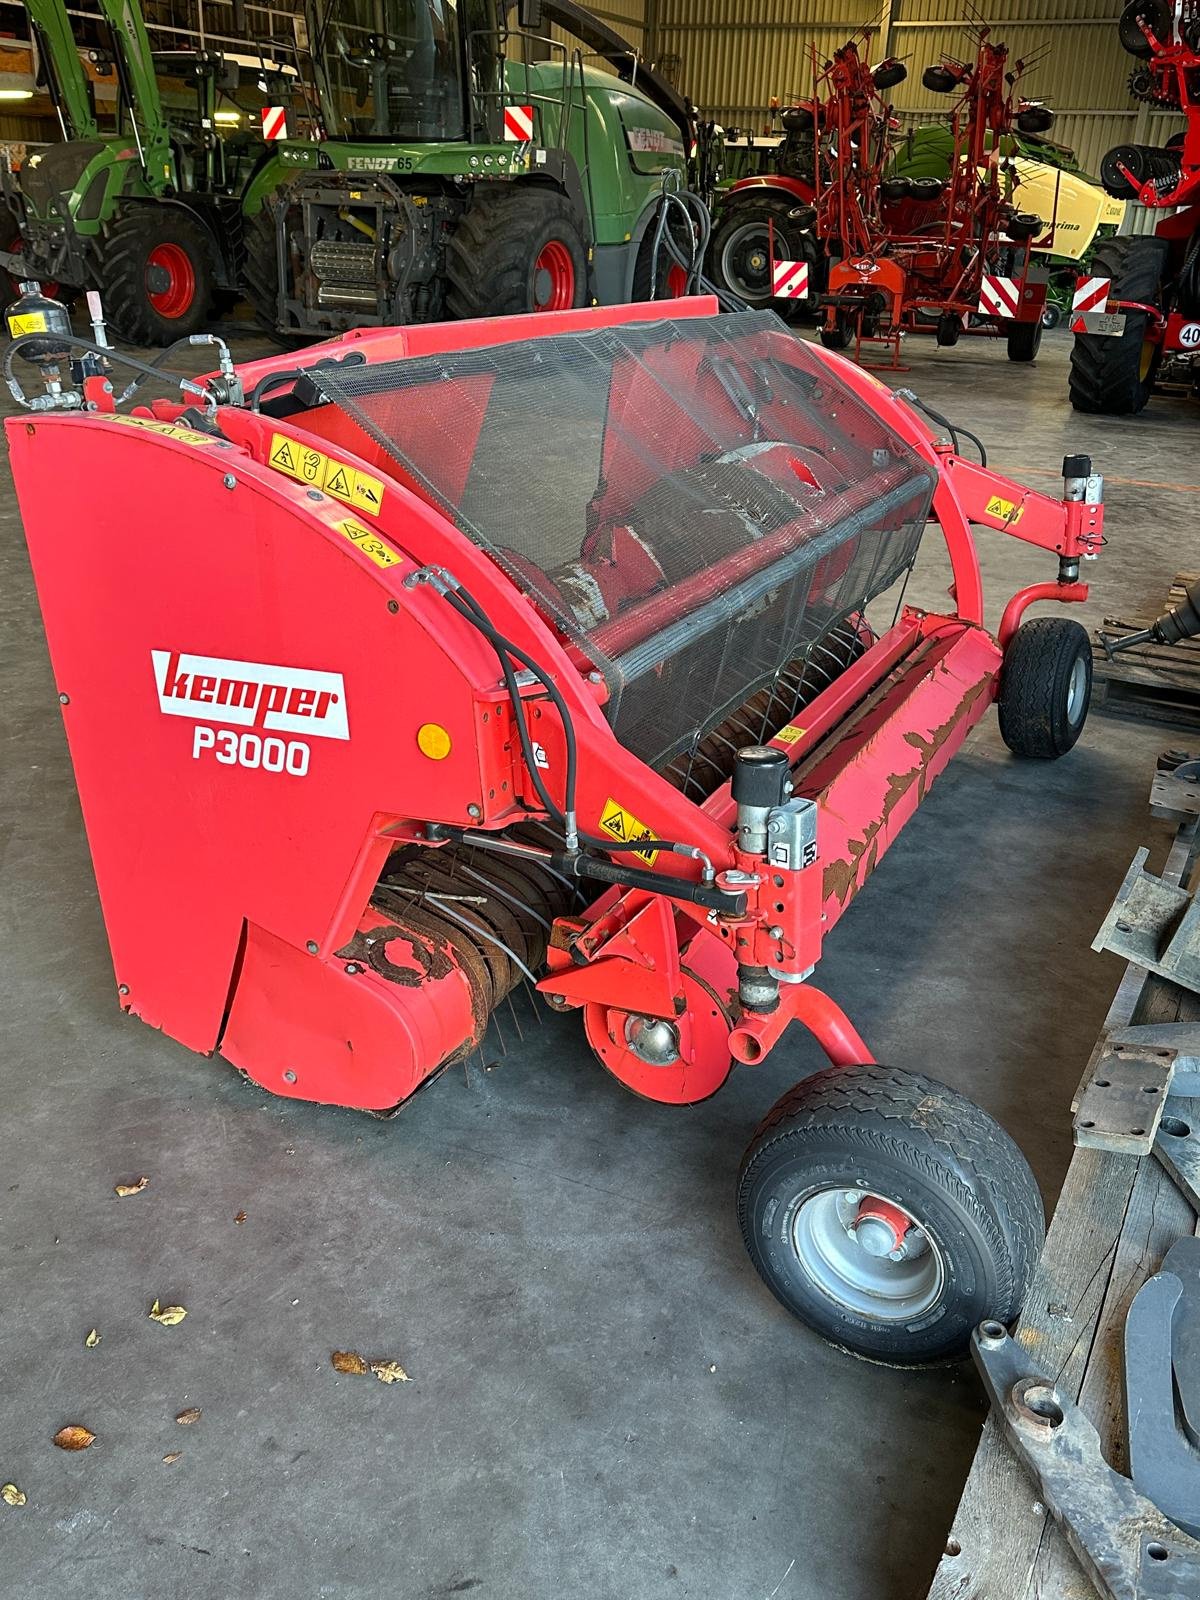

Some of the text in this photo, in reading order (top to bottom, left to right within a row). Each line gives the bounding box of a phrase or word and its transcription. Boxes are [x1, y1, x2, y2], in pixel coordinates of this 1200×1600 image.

[347, 157, 412, 170] FENDT 65
[1182, 327, 1200, 343] 40
[163, 651, 339, 728] kemper
[192, 725, 310, 777] P3000
